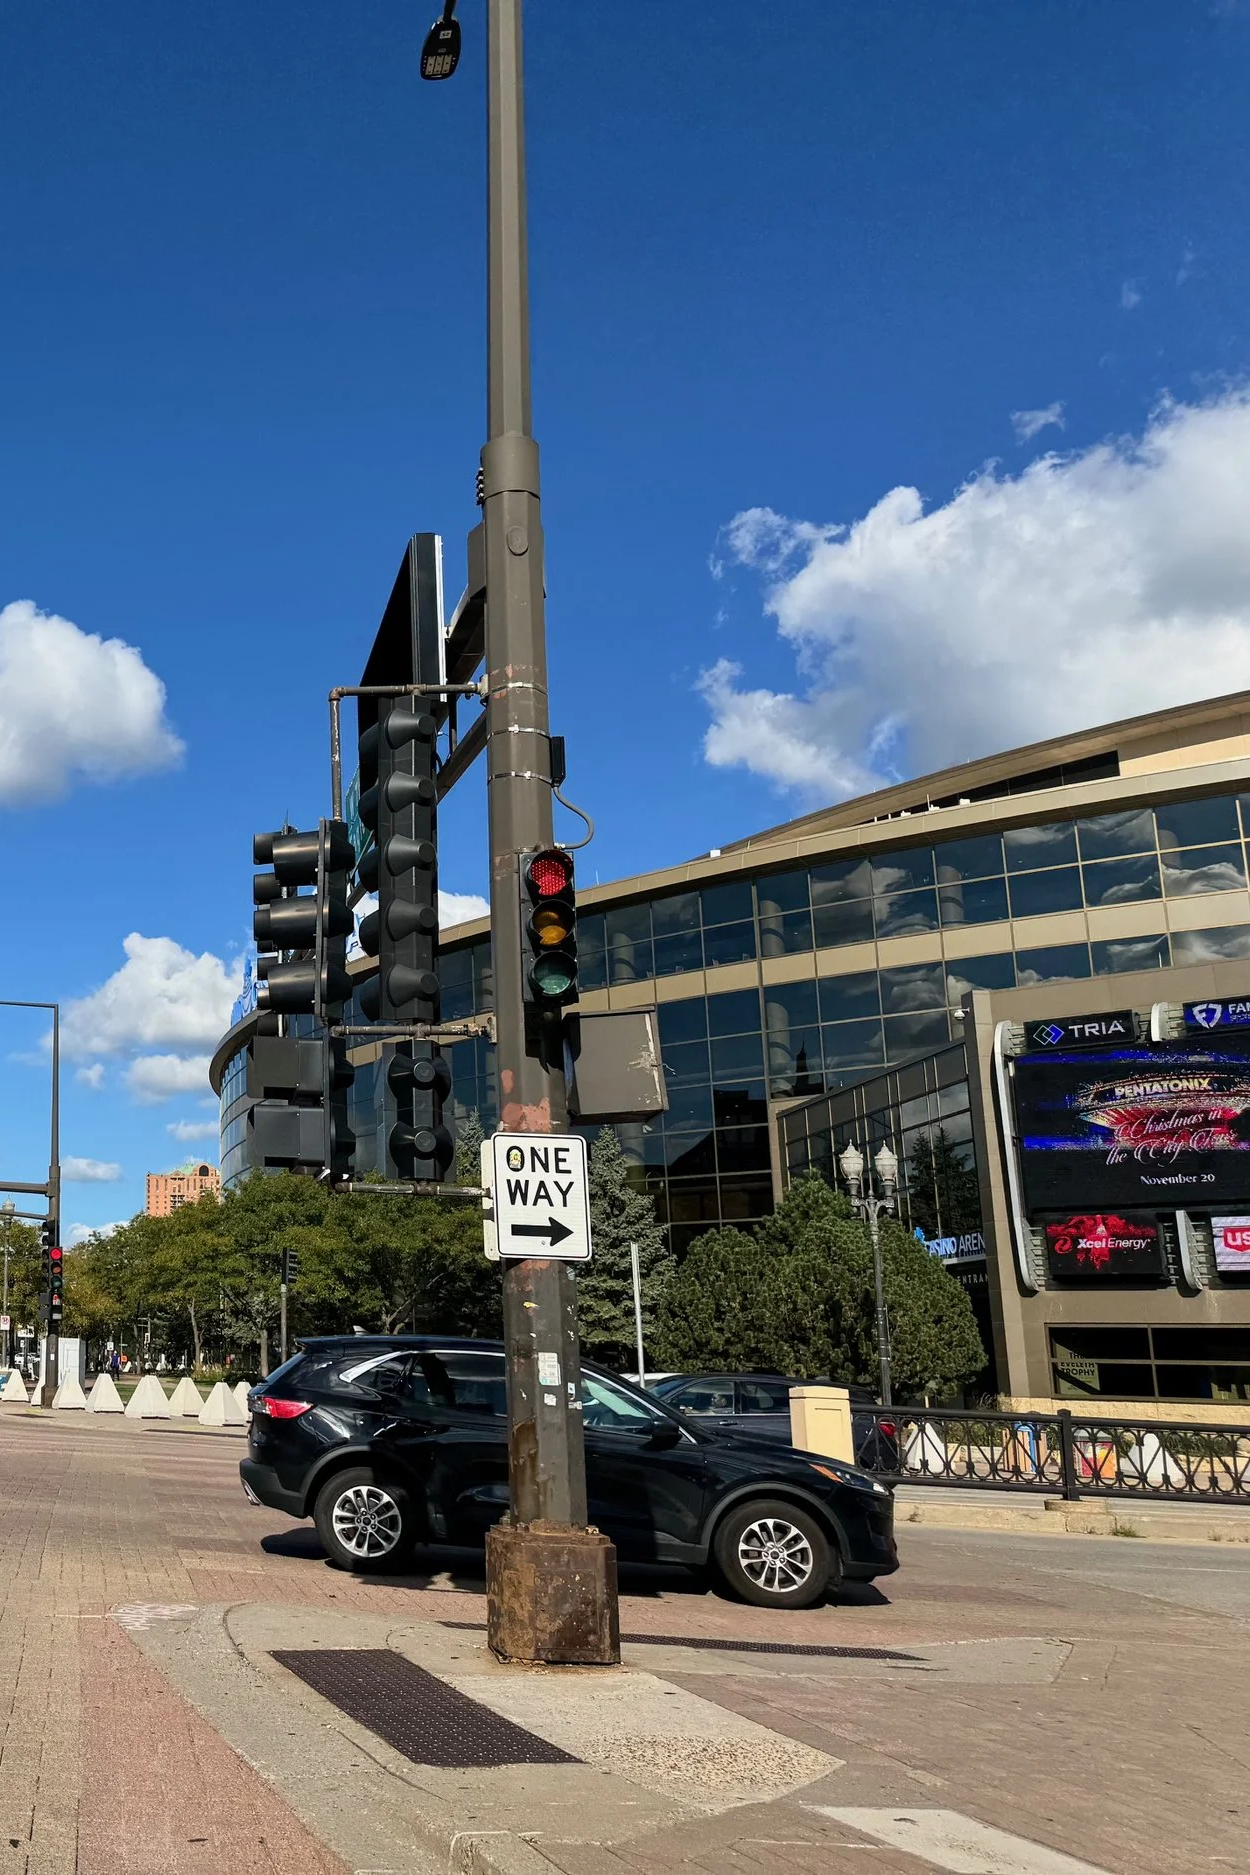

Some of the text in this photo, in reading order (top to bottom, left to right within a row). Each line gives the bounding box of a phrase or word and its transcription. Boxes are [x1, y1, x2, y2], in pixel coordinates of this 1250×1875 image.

[1068, 1020, 1126, 1038] TRIA
[1115, 1077, 1212, 1098] PENTATONIX
[1114, 1107, 1223, 1139] Christmas in
[506, 1145, 572, 1174] ONE
[1106, 1142, 1128, 1166] the
[1134, 1130, 1185, 1168] City
[1140, 1173, 1216, 1185] November 20
[506, 1179, 575, 1208] WAY
[1077, 1237, 1148, 1250] Xcel Energy
[1061, 1367, 1095, 1376] TROPHY
